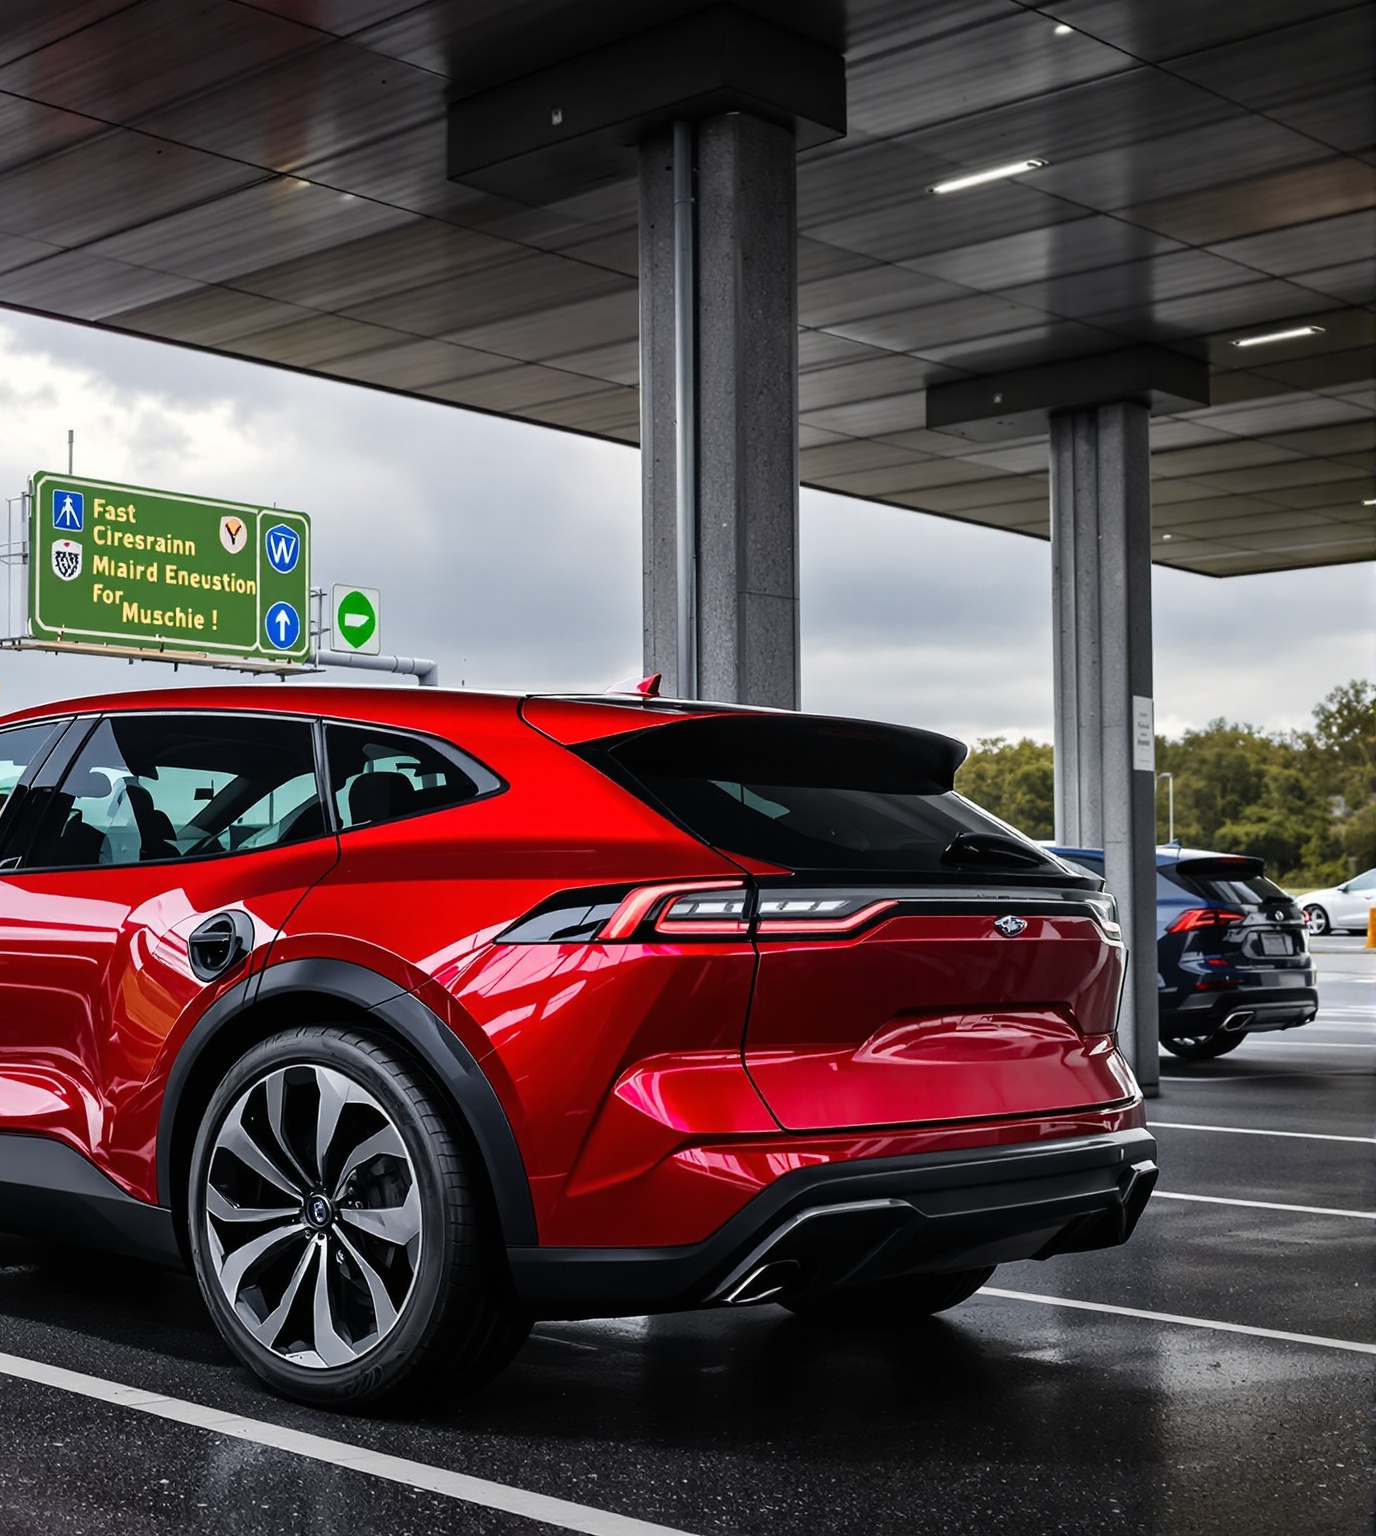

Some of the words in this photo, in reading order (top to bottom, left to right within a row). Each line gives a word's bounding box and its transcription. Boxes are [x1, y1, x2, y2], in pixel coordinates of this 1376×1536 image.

[92, 498, 136, 524] Fast
[165, 565, 256, 595] Eneustion
[92, 583, 124, 604] For
[121, 601, 205, 630] Muschie
